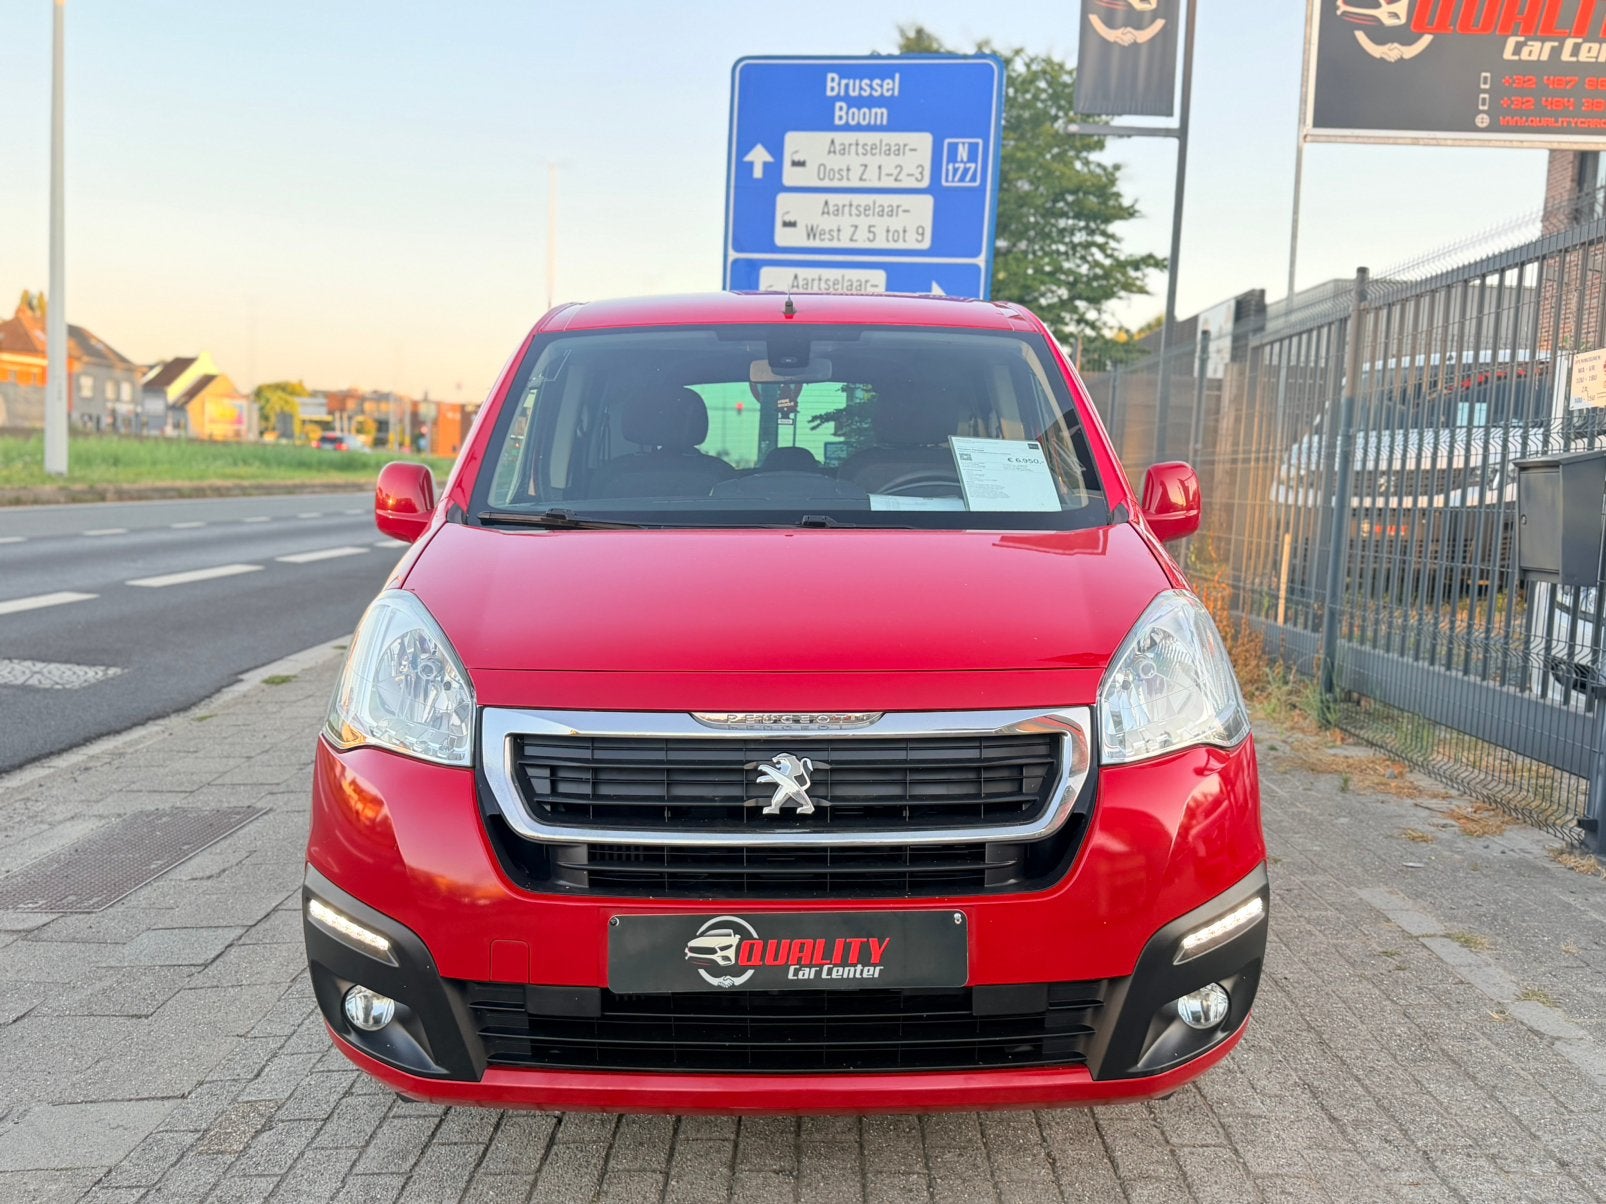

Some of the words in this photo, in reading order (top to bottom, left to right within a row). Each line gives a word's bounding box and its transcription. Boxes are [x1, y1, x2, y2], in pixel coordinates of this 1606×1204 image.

[1410, 0, 1606, 37] QUALI
[1503, 36, 1559, 61] Car
[826, 72, 900, 97] Brussel
[1502, 74, 1536, 89] +32
[1501, 96, 1535, 110] +32
[834, 101, 888, 126] Boom
[826, 137, 918, 157] Aartselaar-
[957, 142, 968, 162] N
[816, 163, 852, 182] Oost
[948, 163, 976, 183] 177
[820, 199, 911, 218] Aartselaar-
[805, 223, 842, 242] West
[885, 225, 907, 243] tot
[915, 225, 926, 244] 9
[790, 272, 879, 292] Aartselaar-
[726, 714, 848, 724] PEUGEOT
[738, 937, 891, 966] QUALITY
[788, 965, 819, 980] Car
[821, 964, 884, 979] Center
